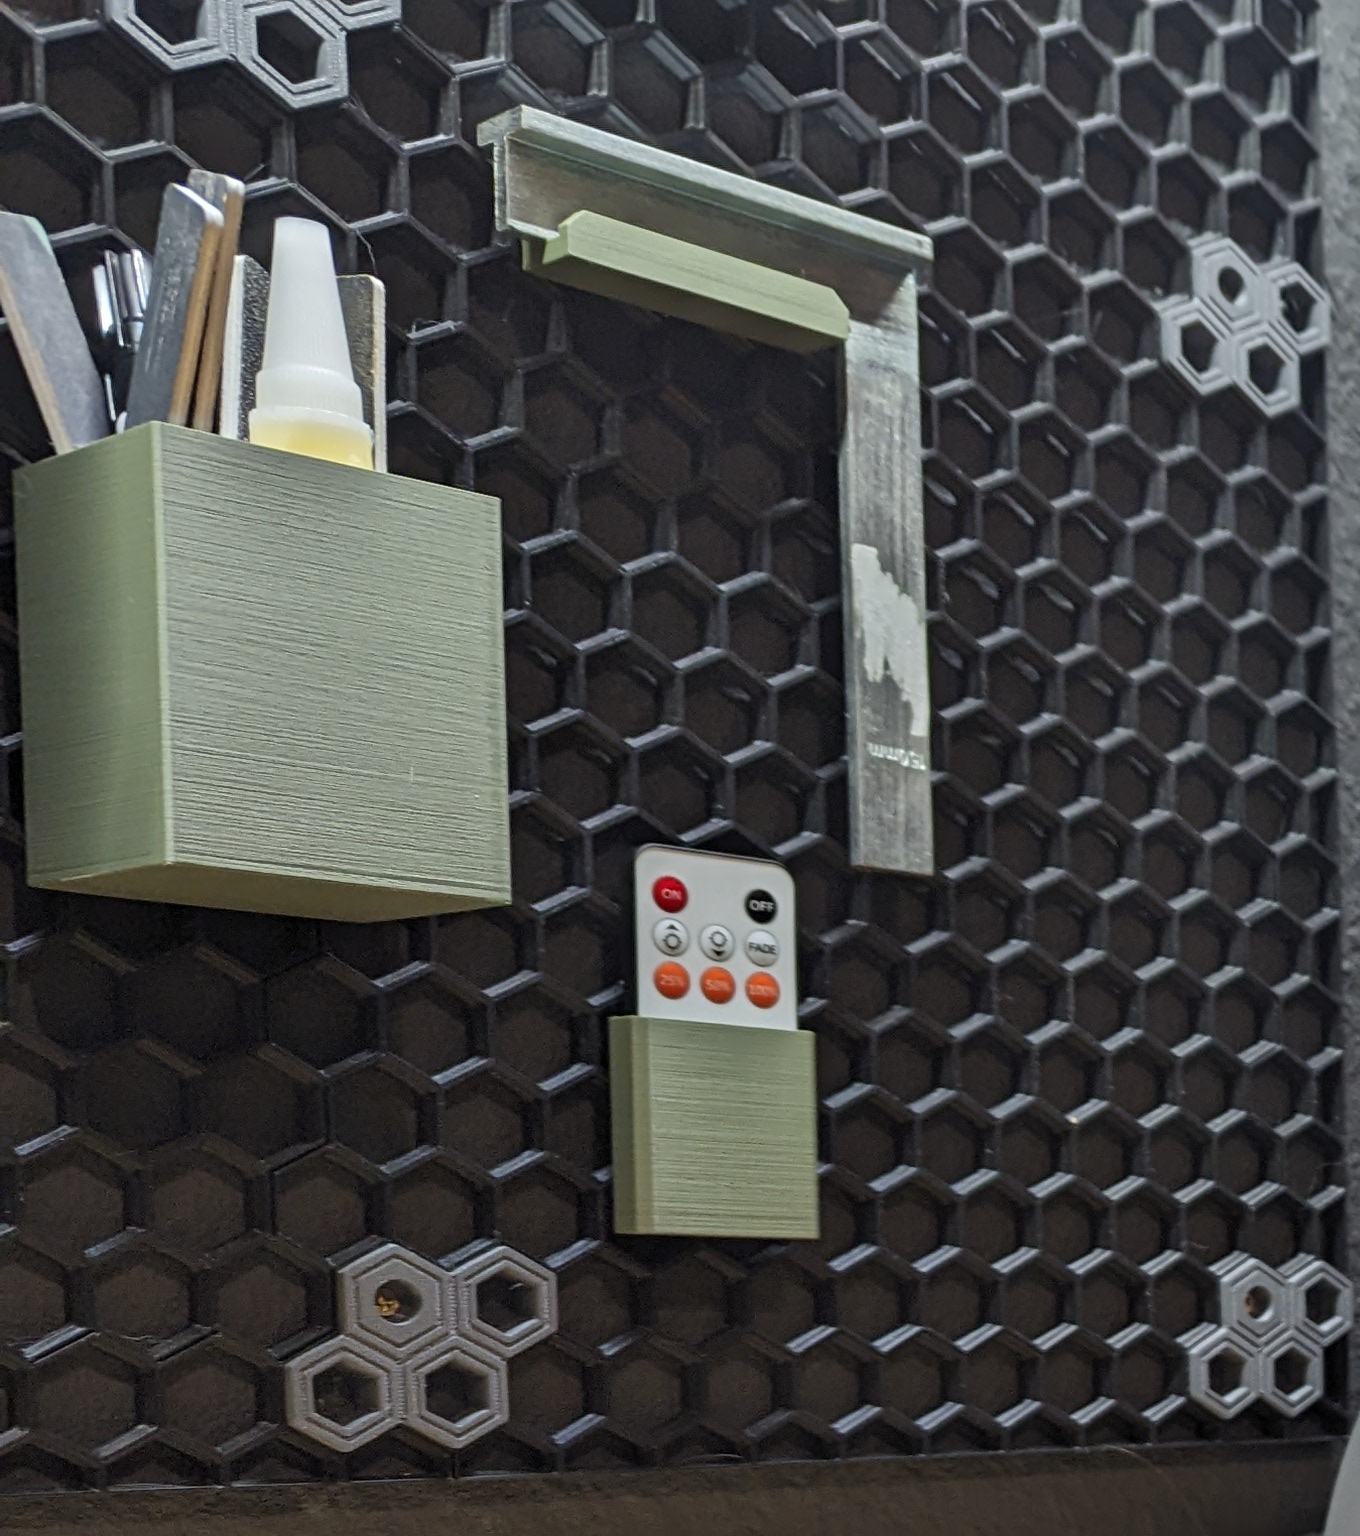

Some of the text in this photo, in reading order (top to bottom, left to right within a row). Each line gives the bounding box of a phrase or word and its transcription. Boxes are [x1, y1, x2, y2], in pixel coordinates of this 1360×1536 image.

[661, 888, 682, 900] ON
[749, 899, 775, 912] OFF
[748, 942, 777, 955] FADE
